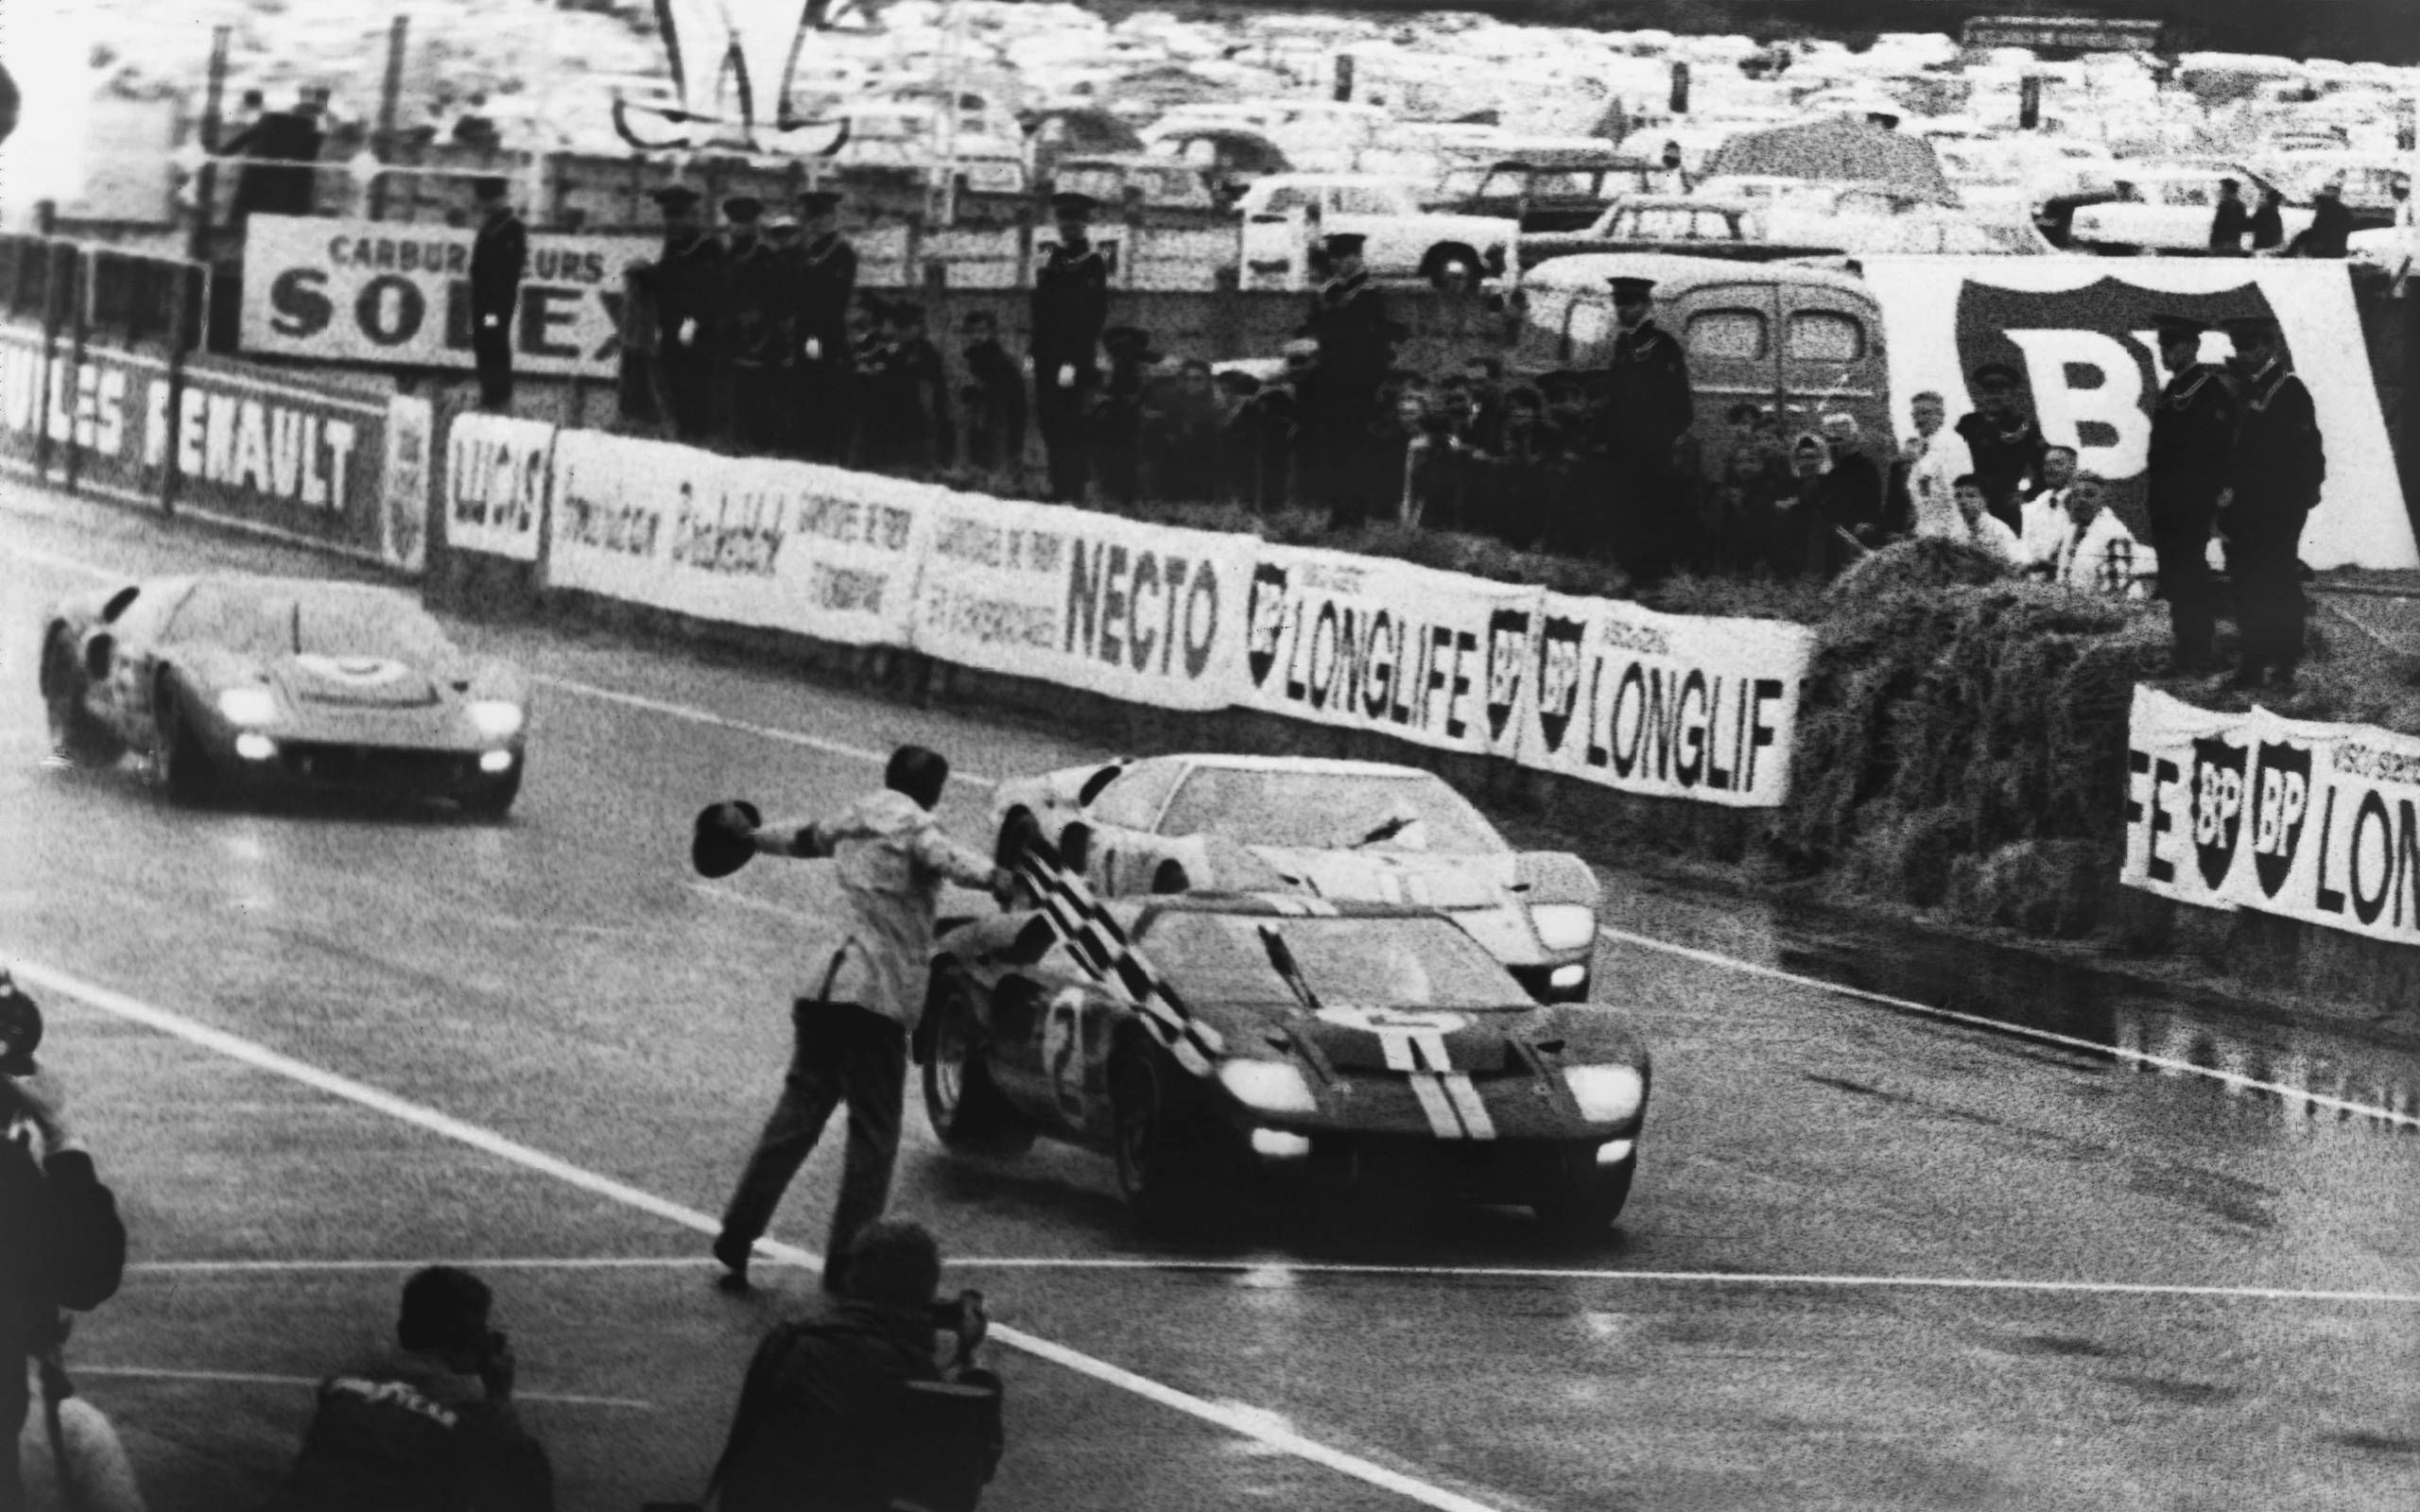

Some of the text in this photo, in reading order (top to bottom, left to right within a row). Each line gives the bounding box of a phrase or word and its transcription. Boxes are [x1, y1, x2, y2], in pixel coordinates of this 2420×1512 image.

[328, 235, 603, 284] CARBURURS
[1065, 538, 1218, 680] NECTO
[1286, 599, 1477, 740] LONGLIFE
[2197, 761, 2241, 849] BP
[2256, 766, 2307, 856] BP
